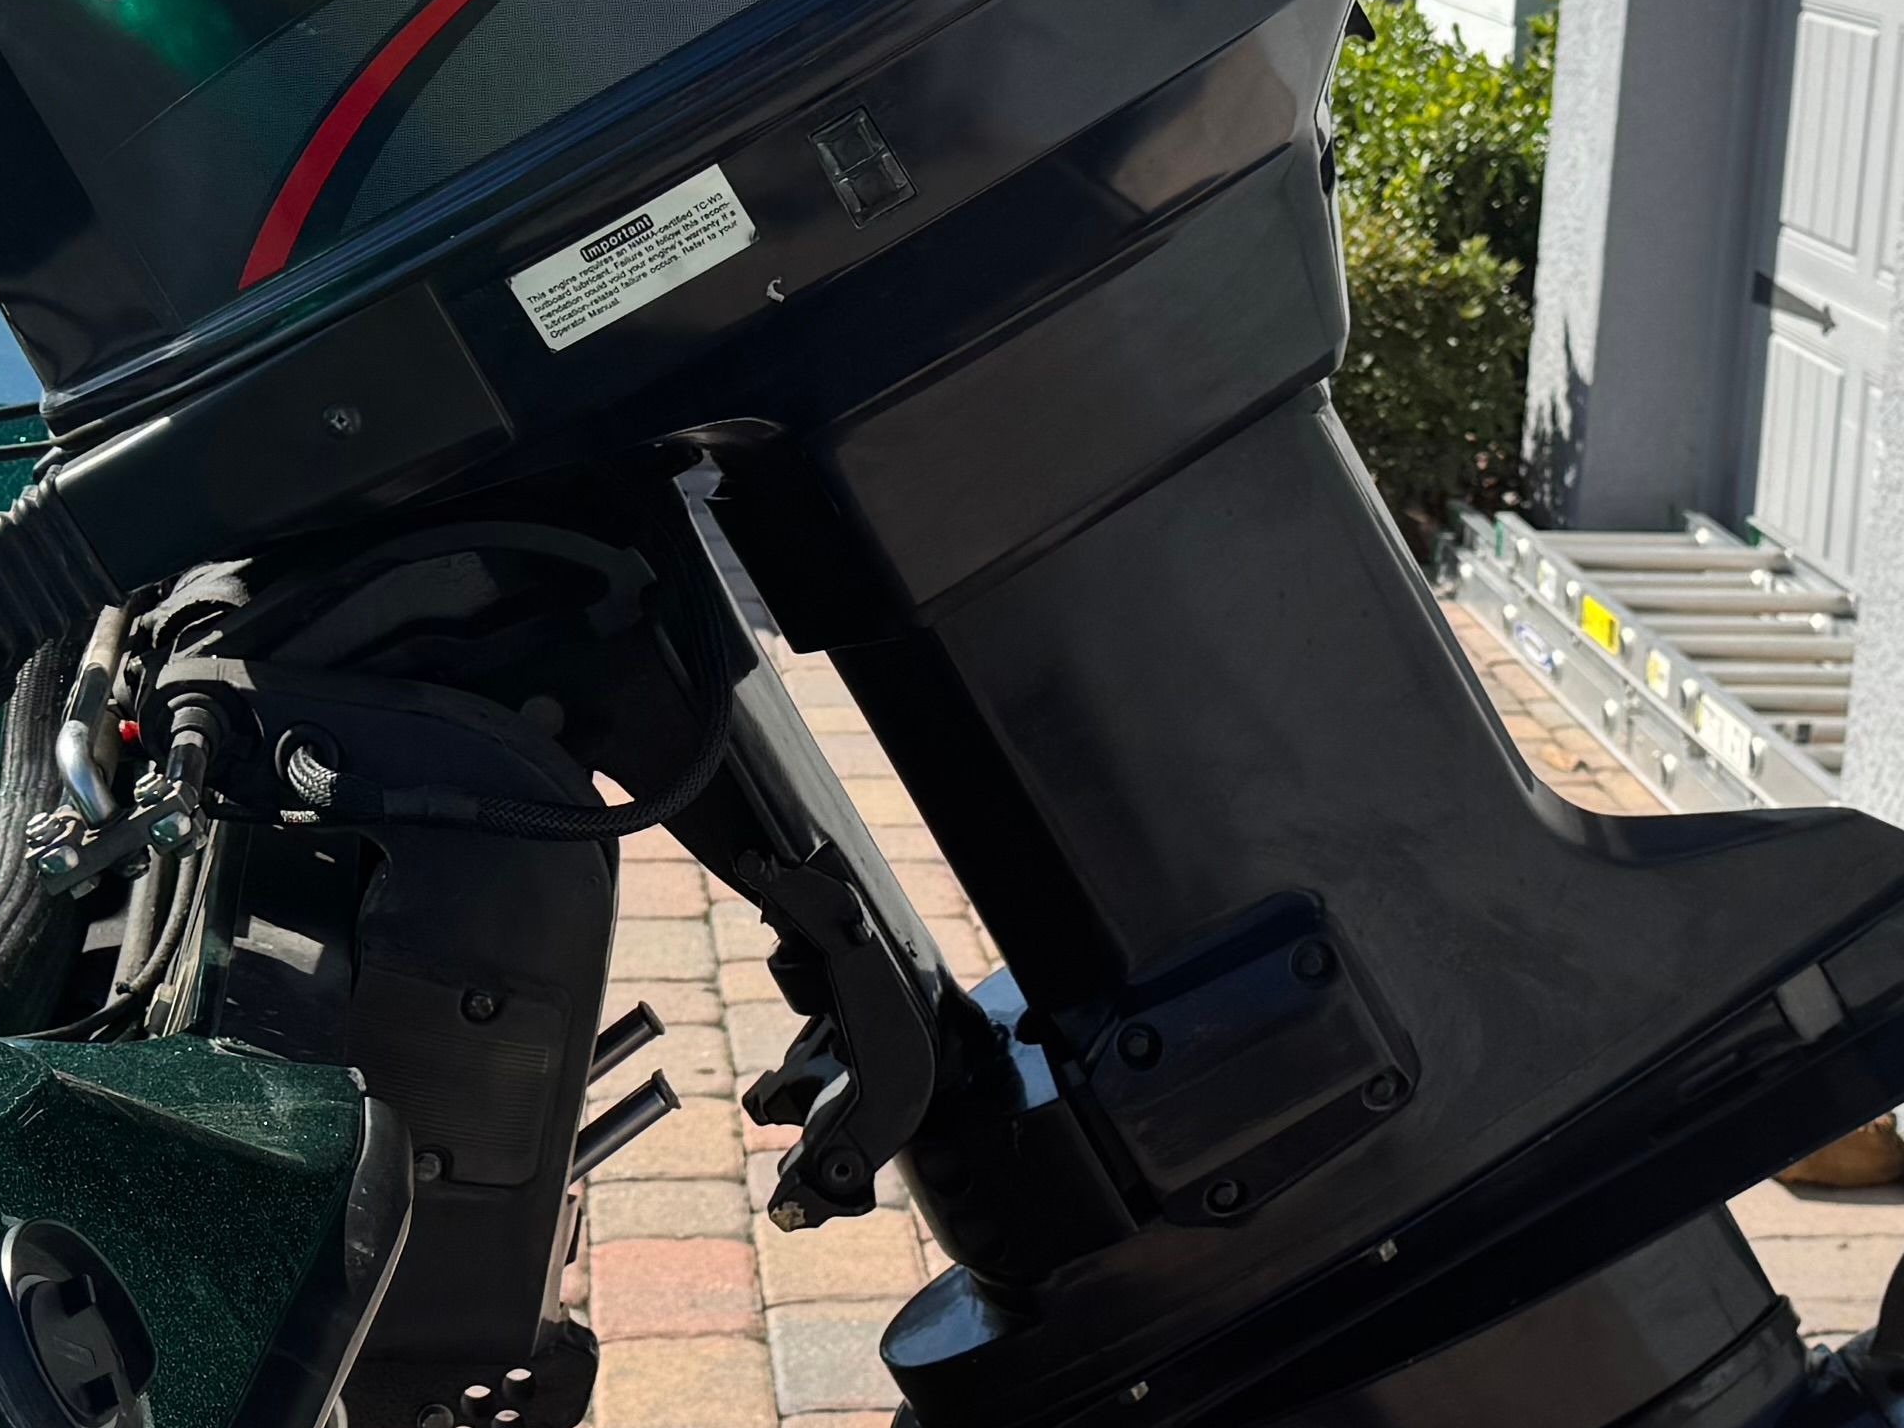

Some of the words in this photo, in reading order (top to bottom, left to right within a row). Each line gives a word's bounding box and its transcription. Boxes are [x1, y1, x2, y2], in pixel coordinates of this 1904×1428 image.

[581, 216, 650, 259] Important
[717, 219, 737, 236] your
[526, 291, 546, 304] This
[547, 275, 577, 294] engine
[578, 254, 614, 277] requires
[533, 288, 572, 313] outboard
[612, 249, 643, 270] Failure
[654, 228, 681, 247] follow
[681, 218, 699, 232] this
[699, 201, 730, 221] recom-
[538, 295, 583, 322] mendation
[583, 280, 607, 298] could
[607, 269, 626, 284] void
[626, 259, 646, 276] your
[683, 218, 720, 242] warranty
[549, 315, 586, 338] Operator
